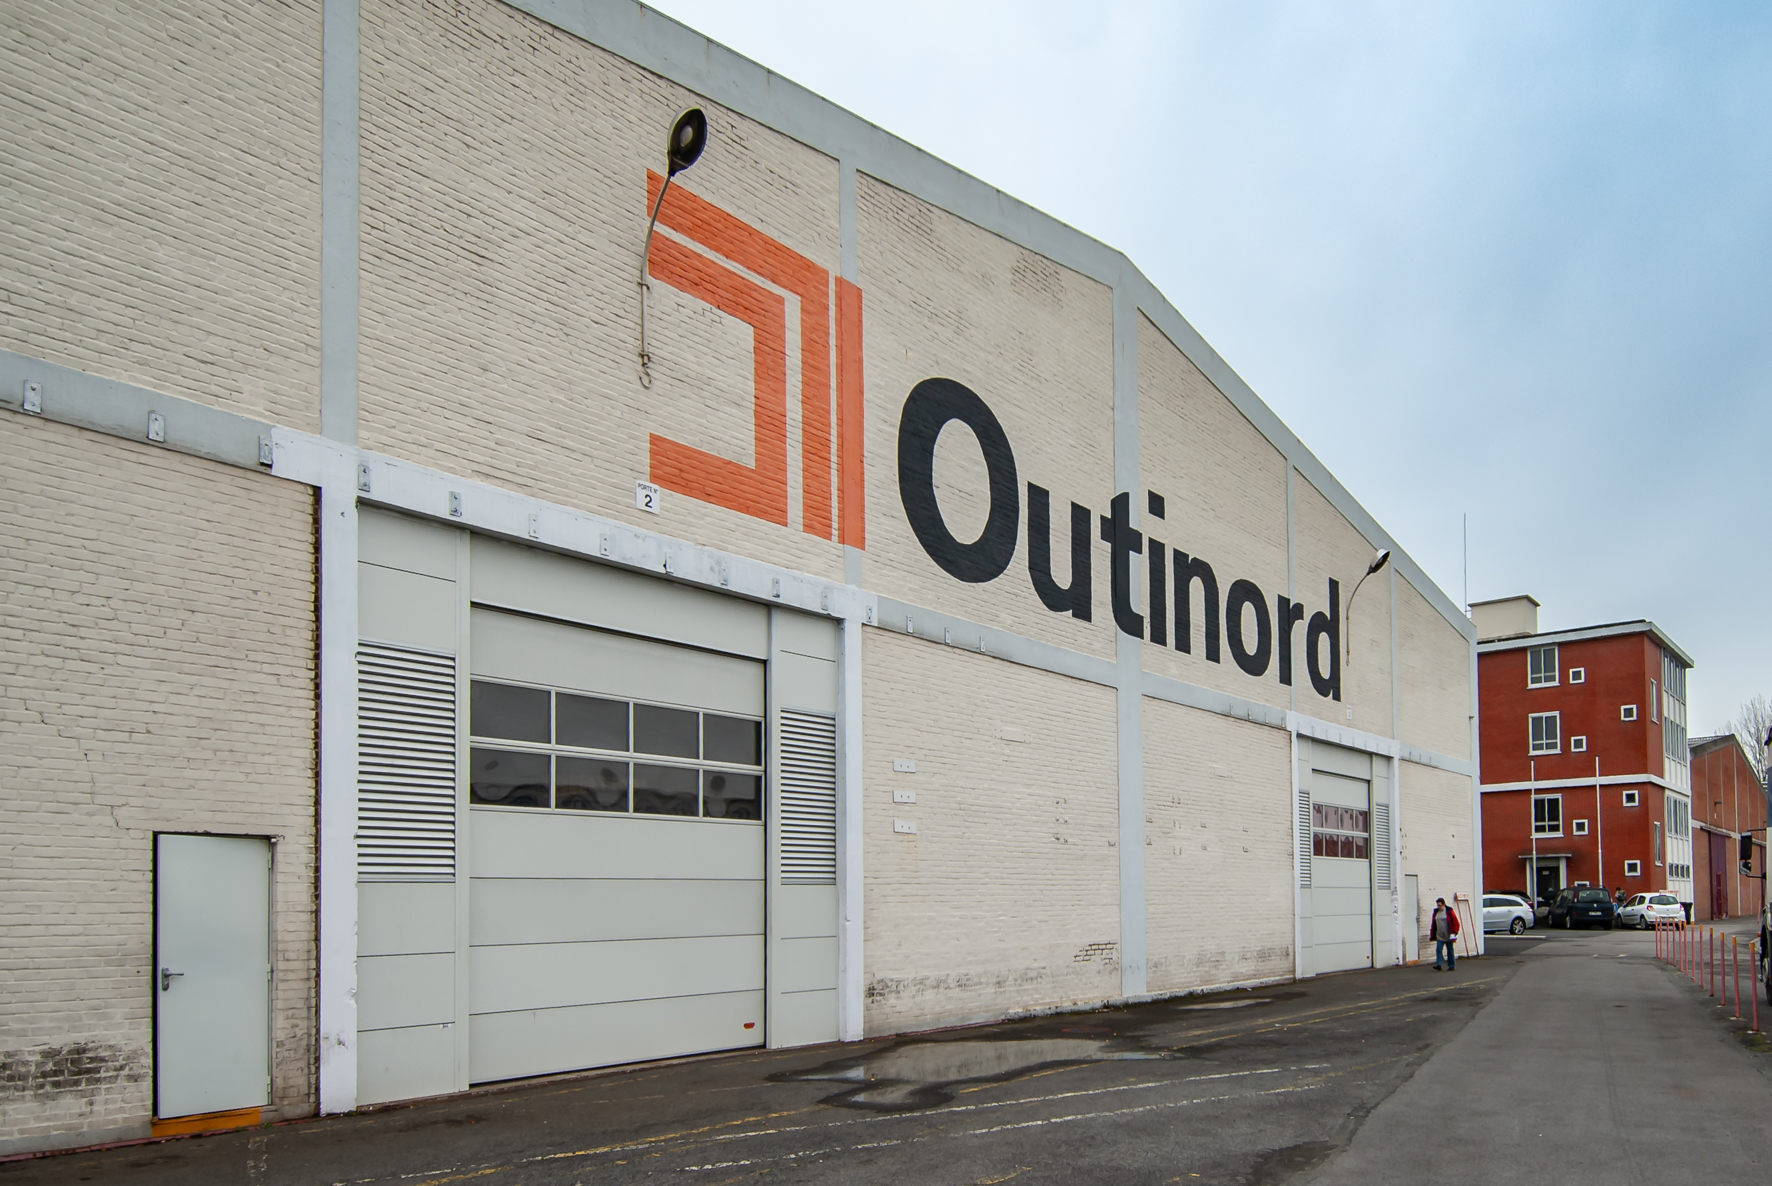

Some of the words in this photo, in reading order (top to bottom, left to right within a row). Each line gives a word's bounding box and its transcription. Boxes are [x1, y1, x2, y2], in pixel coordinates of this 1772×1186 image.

[638, 483, 652, 493] PORTE
[645, 494, 652, 508] 2
[898, 377, 1341, 702] Outinord
